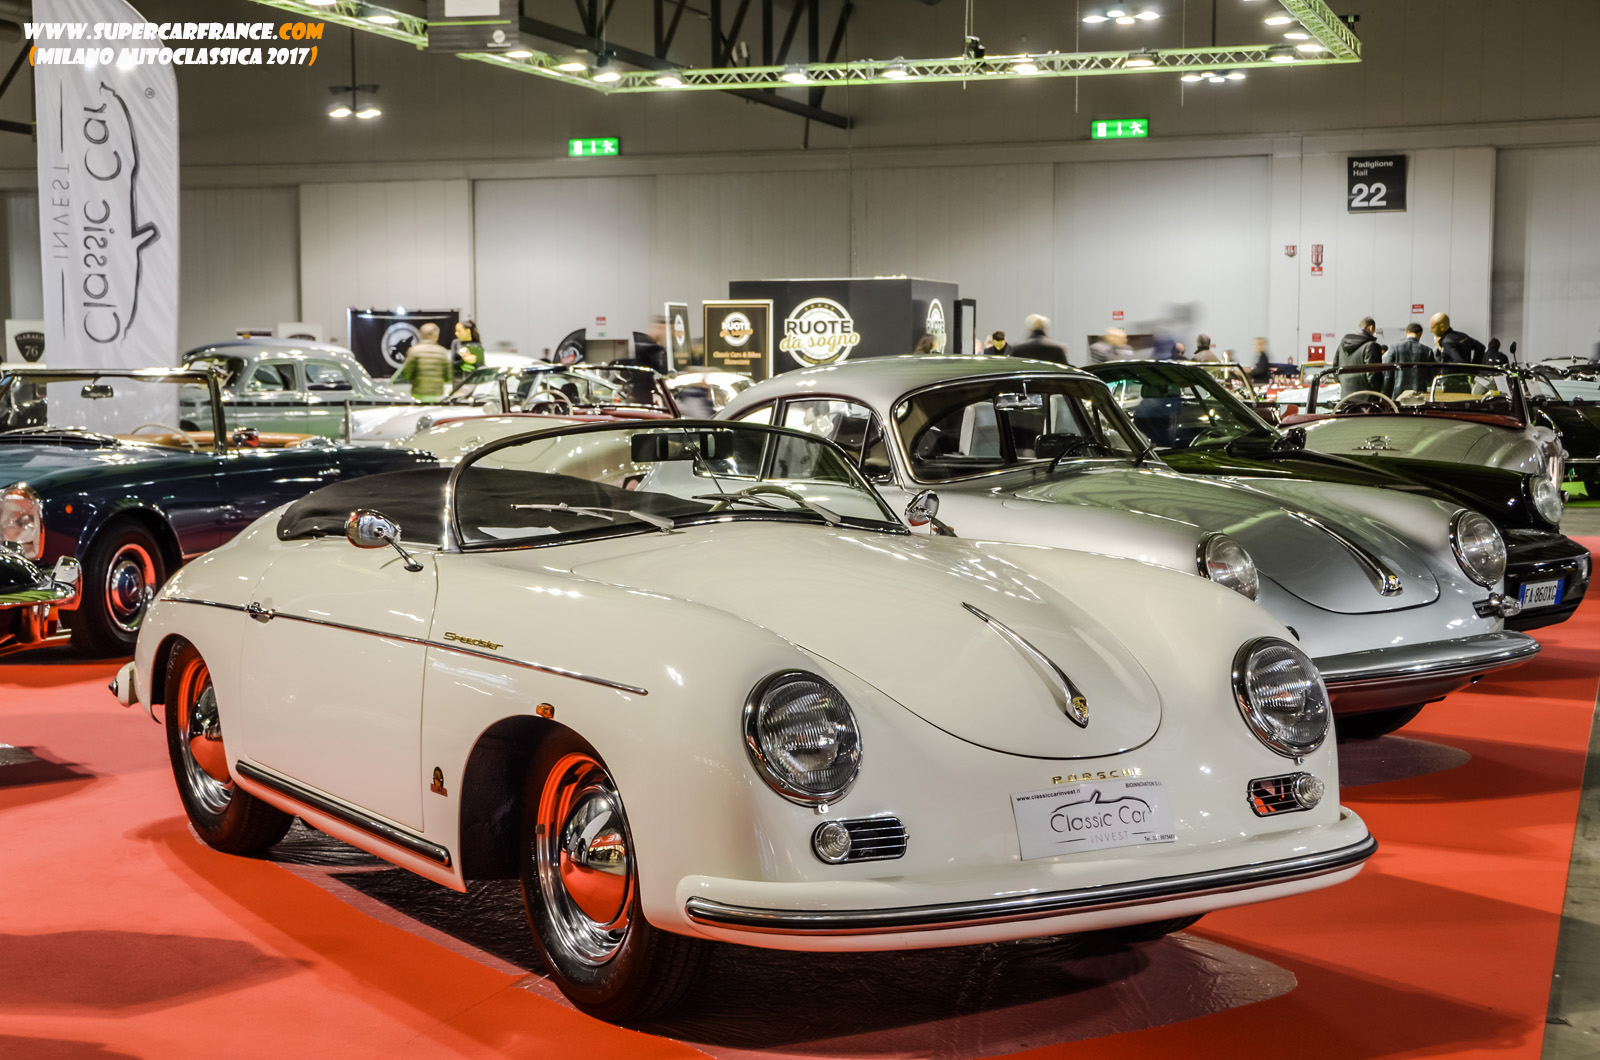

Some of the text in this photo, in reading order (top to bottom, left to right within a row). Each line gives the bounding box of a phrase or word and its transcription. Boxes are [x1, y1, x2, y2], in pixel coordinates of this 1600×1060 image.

[1352, 160, 1394, 169] Padiglione
[1352, 169, 1368, 177] Hall
[1351, 182, 1387, 208] 22
[786, 320, 851, 335] RUOTE
[808, 333, 859, 353] sogno
[24, 345, 39, 357] 76
[1052, 767, 1142, 785] PORSCHE
[1050, 805, 1146, 833] Classic Car
[1090, 831, 1128, 844] INVEST
